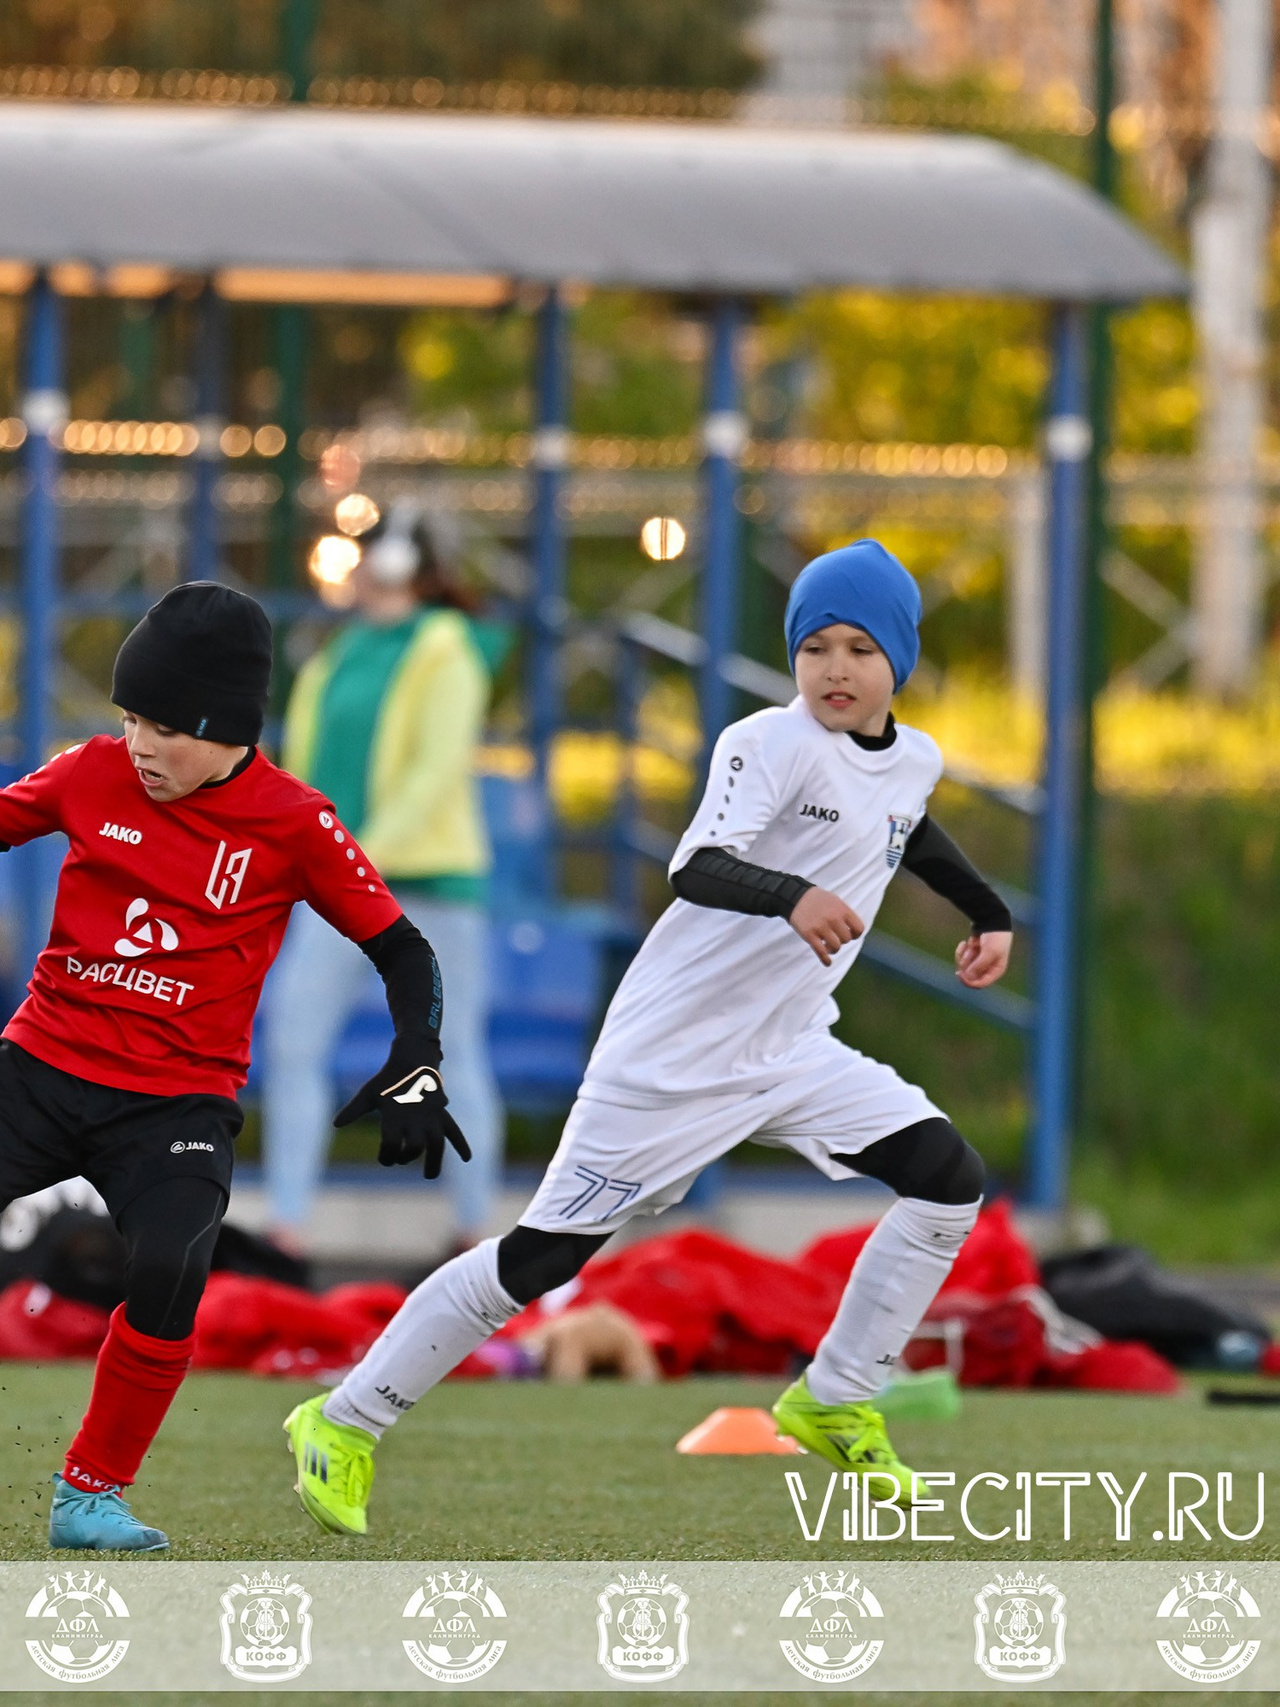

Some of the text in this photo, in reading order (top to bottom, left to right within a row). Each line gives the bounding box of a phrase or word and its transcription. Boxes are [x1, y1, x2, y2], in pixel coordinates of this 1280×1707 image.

[799, 803, 840, 823] JAKO
[98, 822, 143, 845] JAKO
[66, 955, 195, 1006] РАСЦВЕТ
[185, 1141, 215, 1153] JAKO
[558, 1164, 643, 1223] 77
